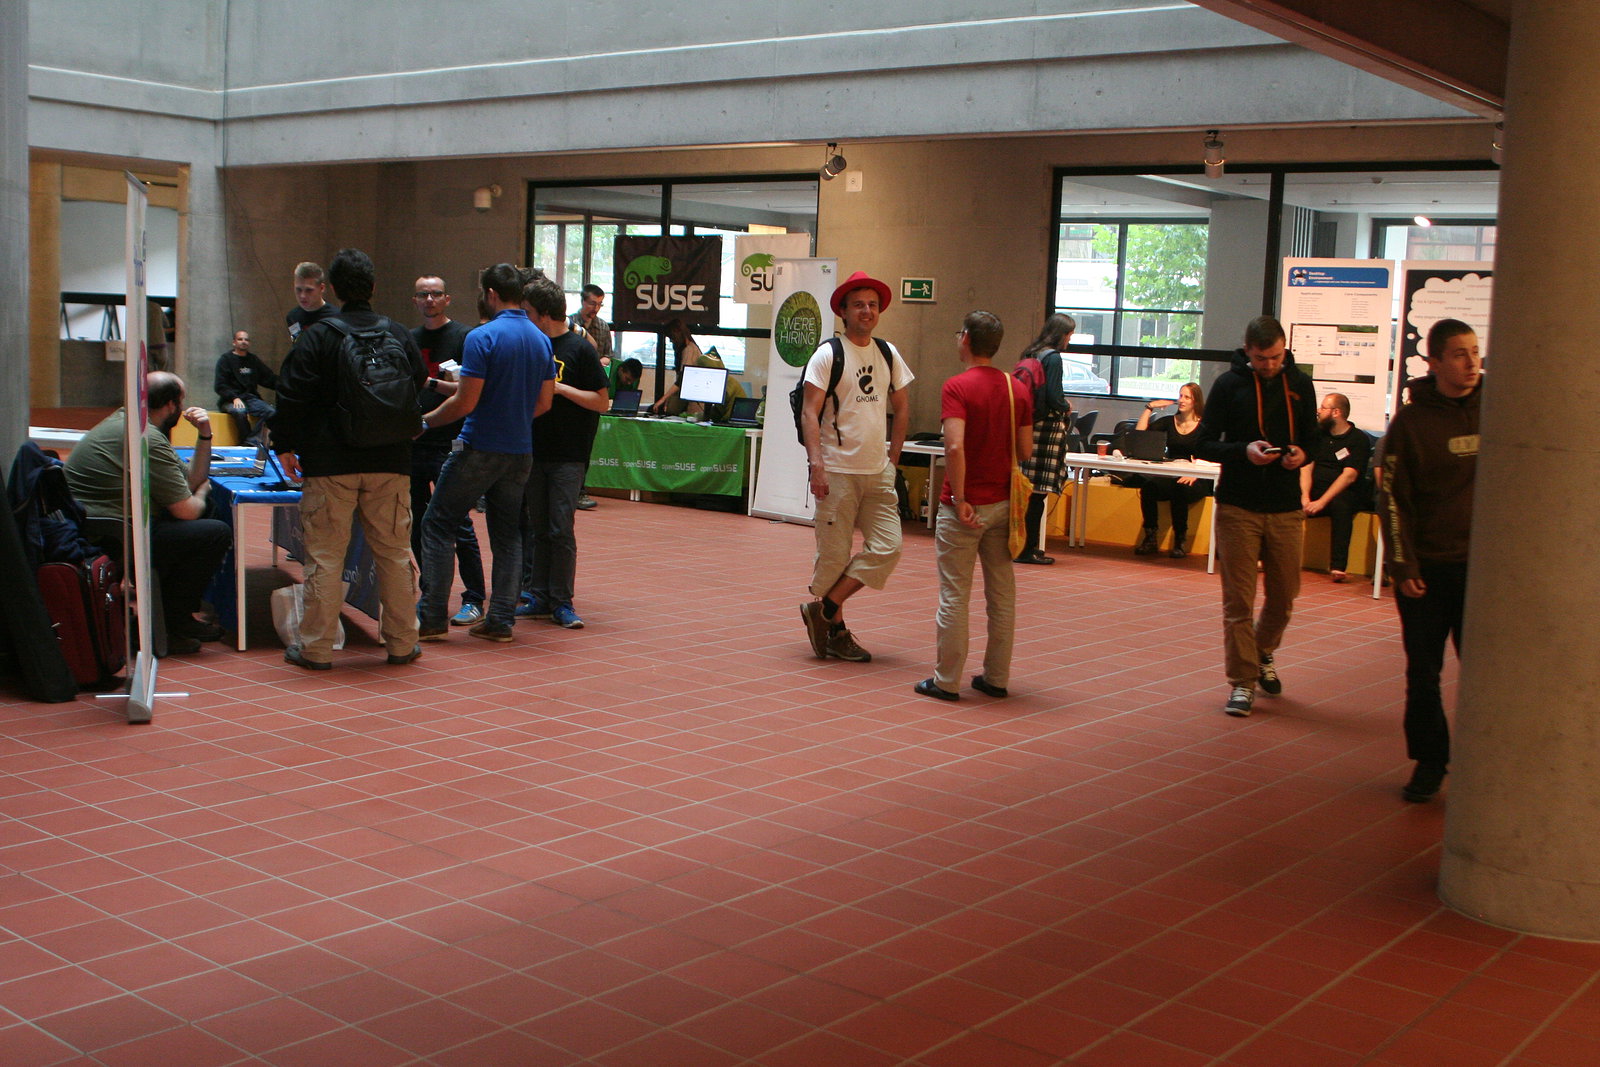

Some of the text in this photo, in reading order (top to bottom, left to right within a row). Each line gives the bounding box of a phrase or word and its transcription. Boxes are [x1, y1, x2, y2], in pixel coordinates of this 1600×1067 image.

[636, 284, 705, 311] SUSE
[783, 316, 816, 331] WE'RE
[780, 331, 816, 345] HIRING
[623, 460, 656, 468] openSUSE
[662, 462, 696, 471] openSUSE
[700, 464, 738, 472] openSUSE
